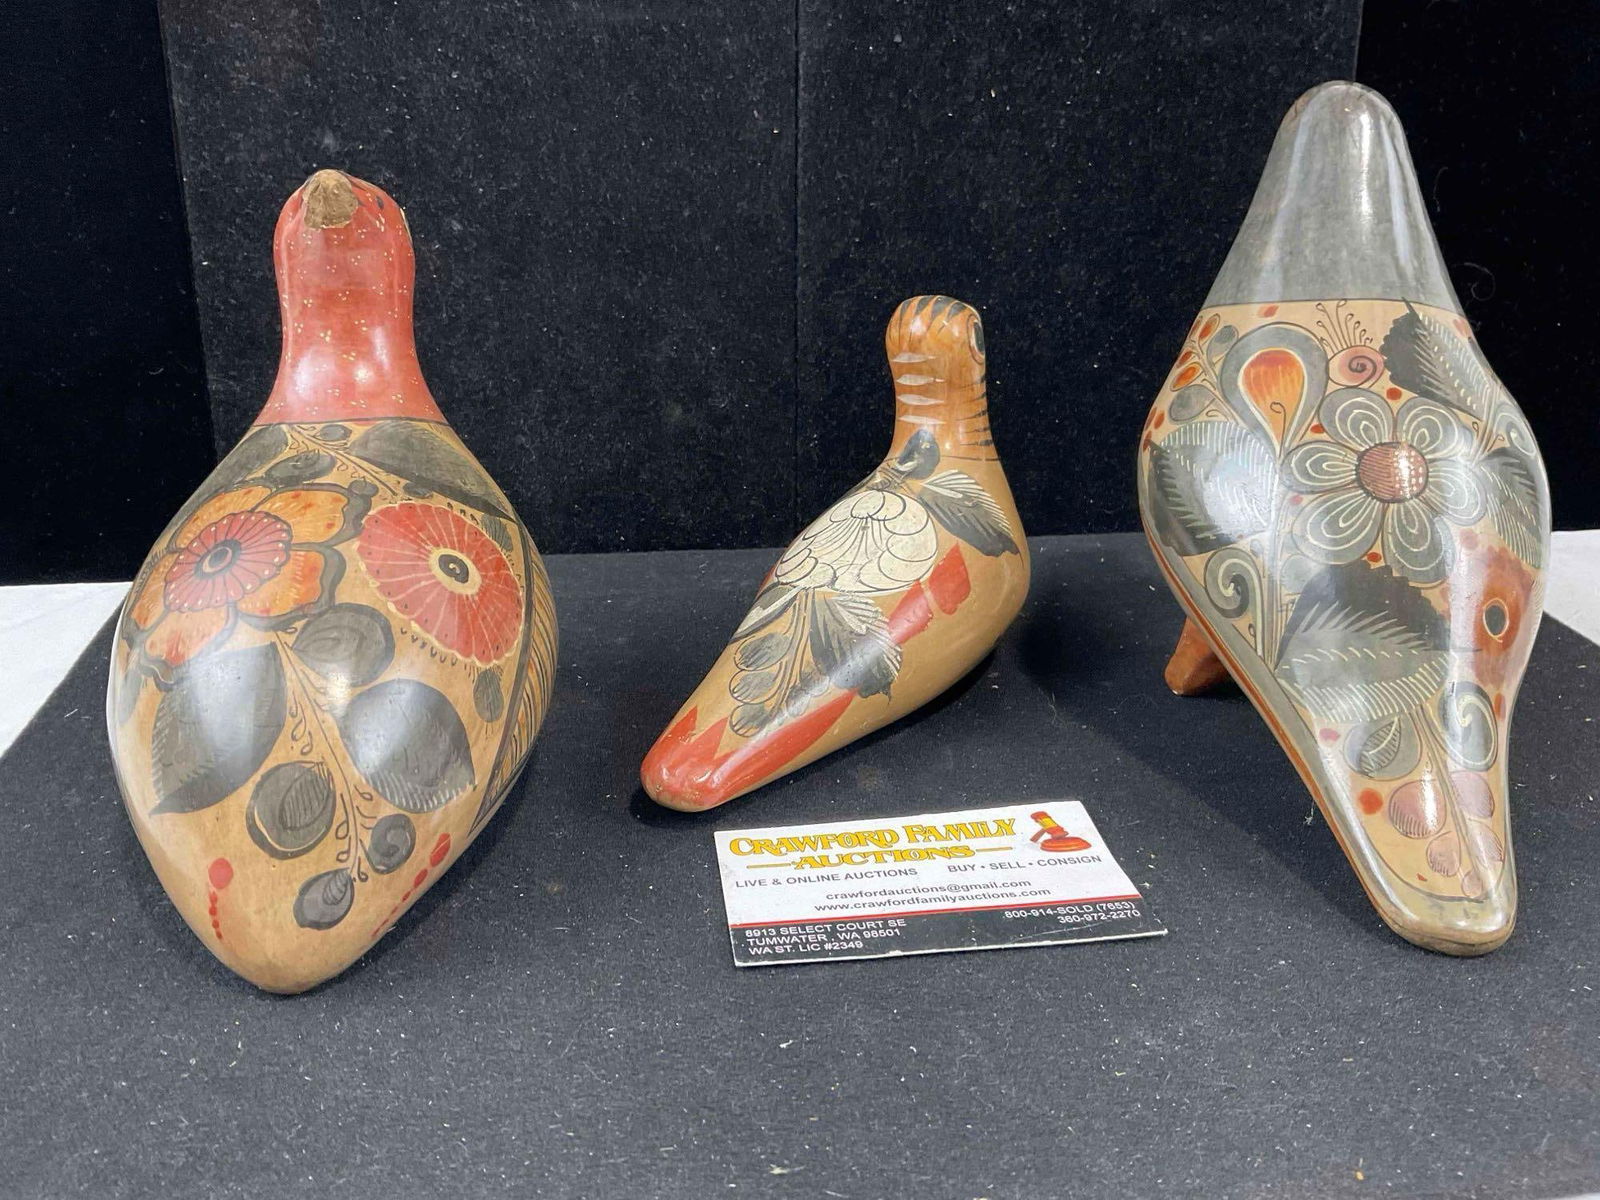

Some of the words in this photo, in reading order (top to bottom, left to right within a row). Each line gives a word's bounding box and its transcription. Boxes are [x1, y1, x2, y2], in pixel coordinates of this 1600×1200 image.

[729, 829, 899, 857] CRAWFORD
[902, 818, 1016, 843] FAMILY
[793, 845, 976, 870] AUCTIONS
[947, 863, 976, 873] BUY
[989, 861, 1026, 871] SELL
[1037, 855, 1103, 868] CONSIGN
[735, 878, 767, 888] LIVE
[771, 877, 783, 886] &
[786, 872, 841, 885] ONLINE
[844, 868, 918, 880] AUCTIONS
[814, 887, 1051, 912] www.crawfordfamilyauctions.com
[825, 879, 1032, 900] crawfordauctions@gmail.com
[779, 924, 832, 936] SELECT
[836, 921, 884, 931] COURT
[888, 918, 907, 928] SE
[747, 933, 827, 947] TUMWATER
[837, 932, 861, 941] WA
[863, 928, 902, 939] 98501
[749, 947, 773, 956] WA
[775, 945, 795, 954] ST.
[798, 942, 821, 952] LIC
